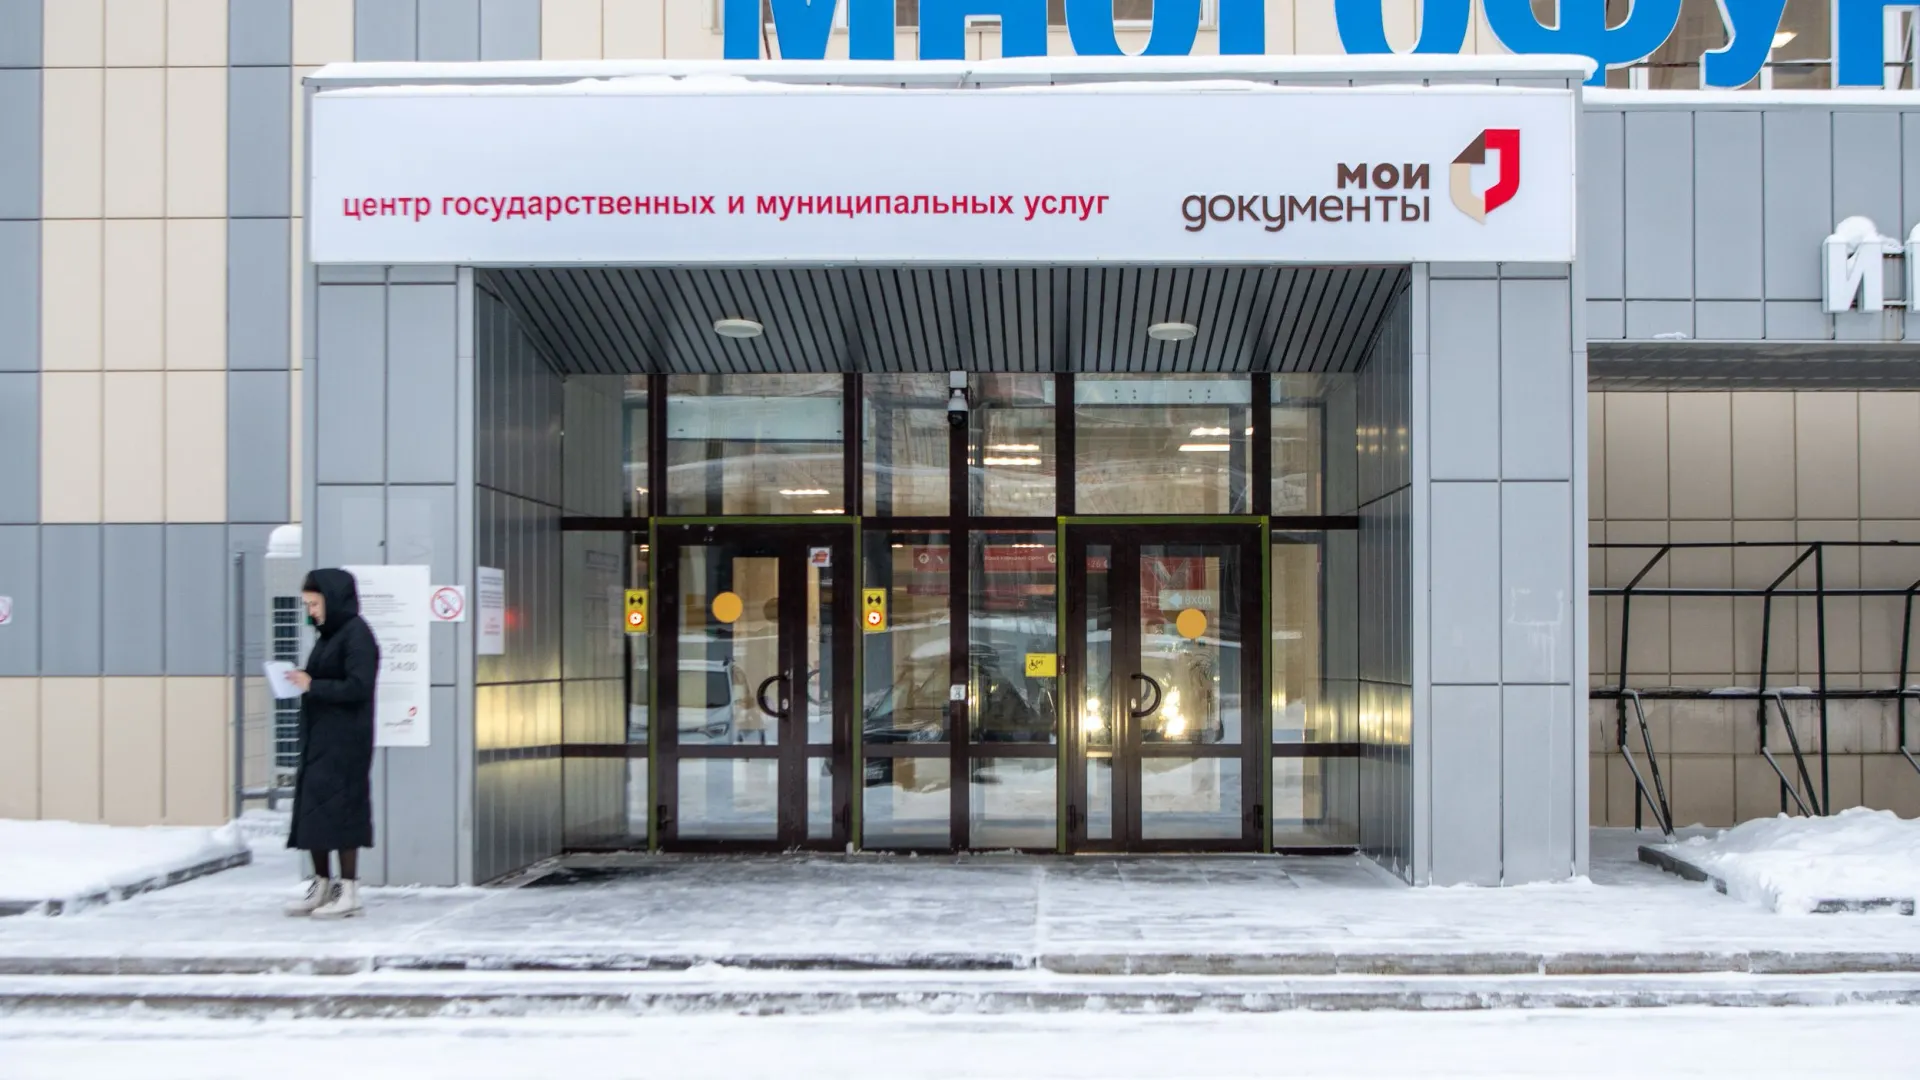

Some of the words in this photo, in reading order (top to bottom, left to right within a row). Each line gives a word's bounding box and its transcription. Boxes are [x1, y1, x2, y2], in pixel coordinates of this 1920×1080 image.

[1337, 162, 1430, 190] мои
[343, 196, 432, 222] центр
[441, 195, 715, 223] государственных
[727, 195, 745, 215] и
[755, 194, 1013, 222] муниципальных
[1023, 194, 1110, 222] услуг
[1181, 194, 1430, 233] документы
